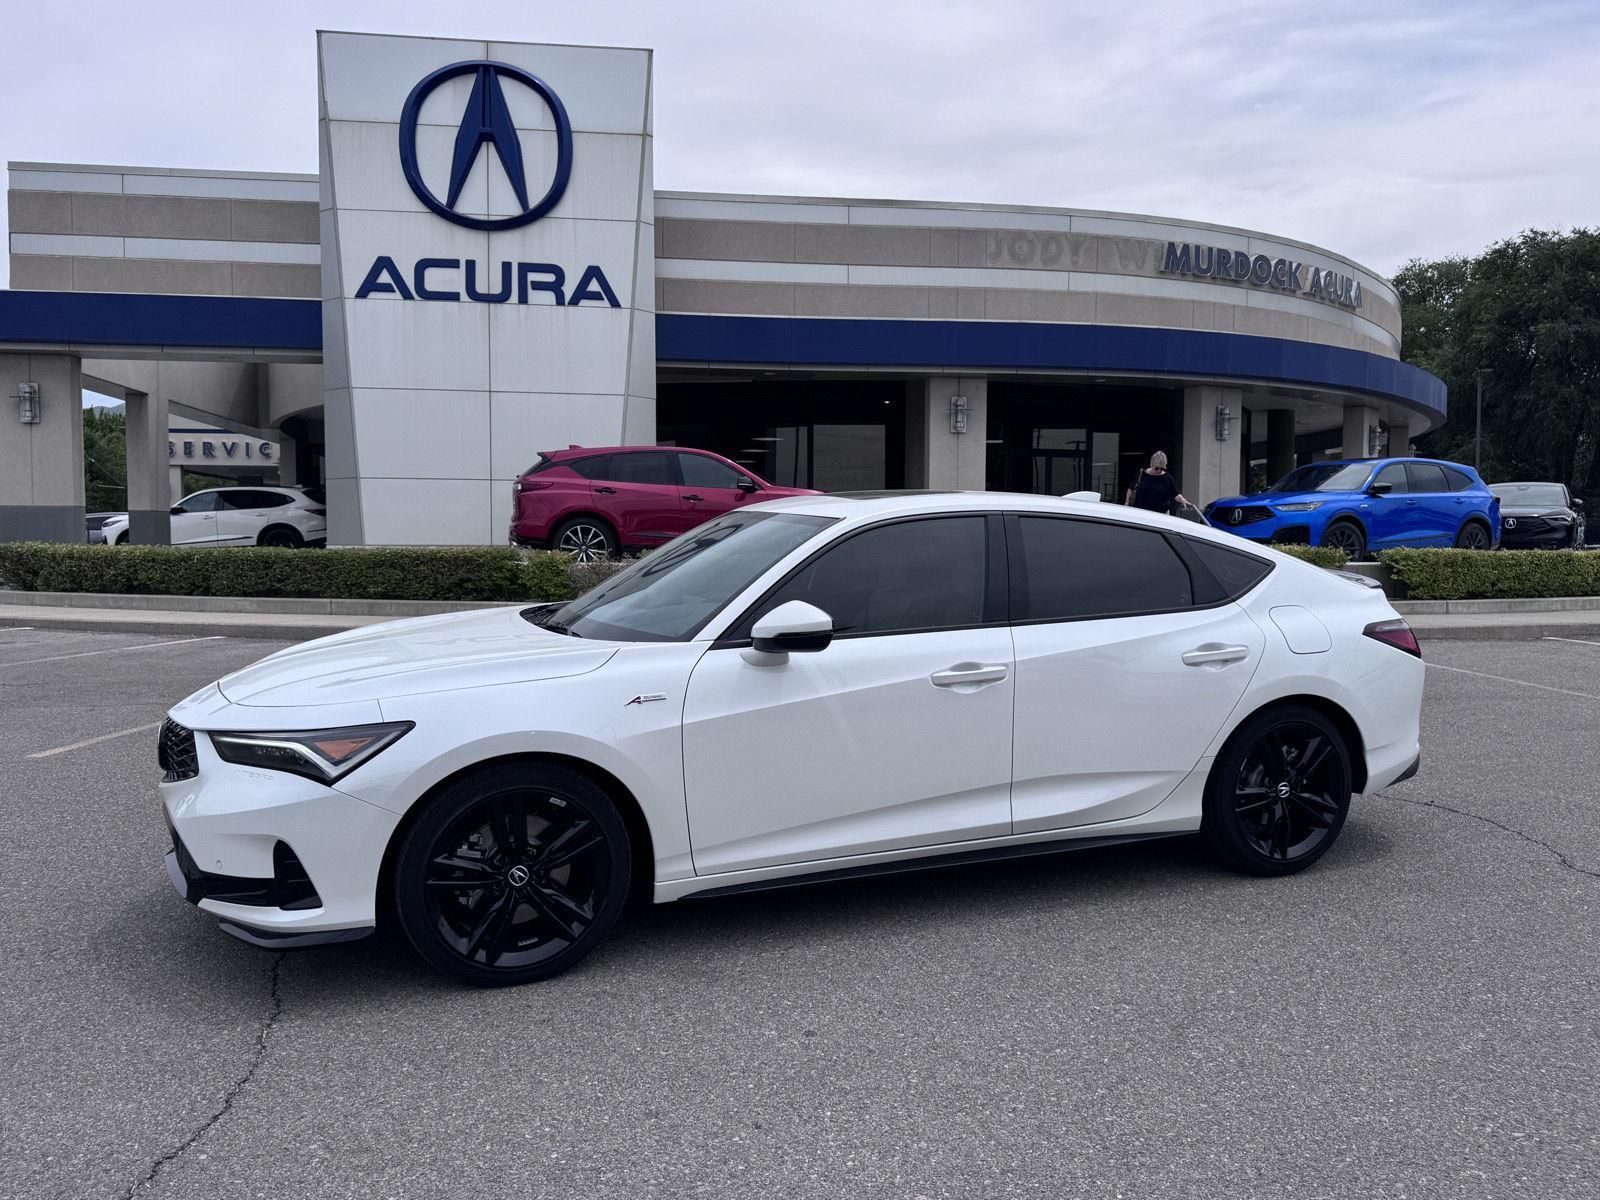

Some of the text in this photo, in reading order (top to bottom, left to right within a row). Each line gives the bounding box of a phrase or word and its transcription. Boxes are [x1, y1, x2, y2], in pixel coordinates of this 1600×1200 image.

[354, 255, 622, 308] ACURA
[1163, 241, 1362, 309] MURDOCK ACURA
